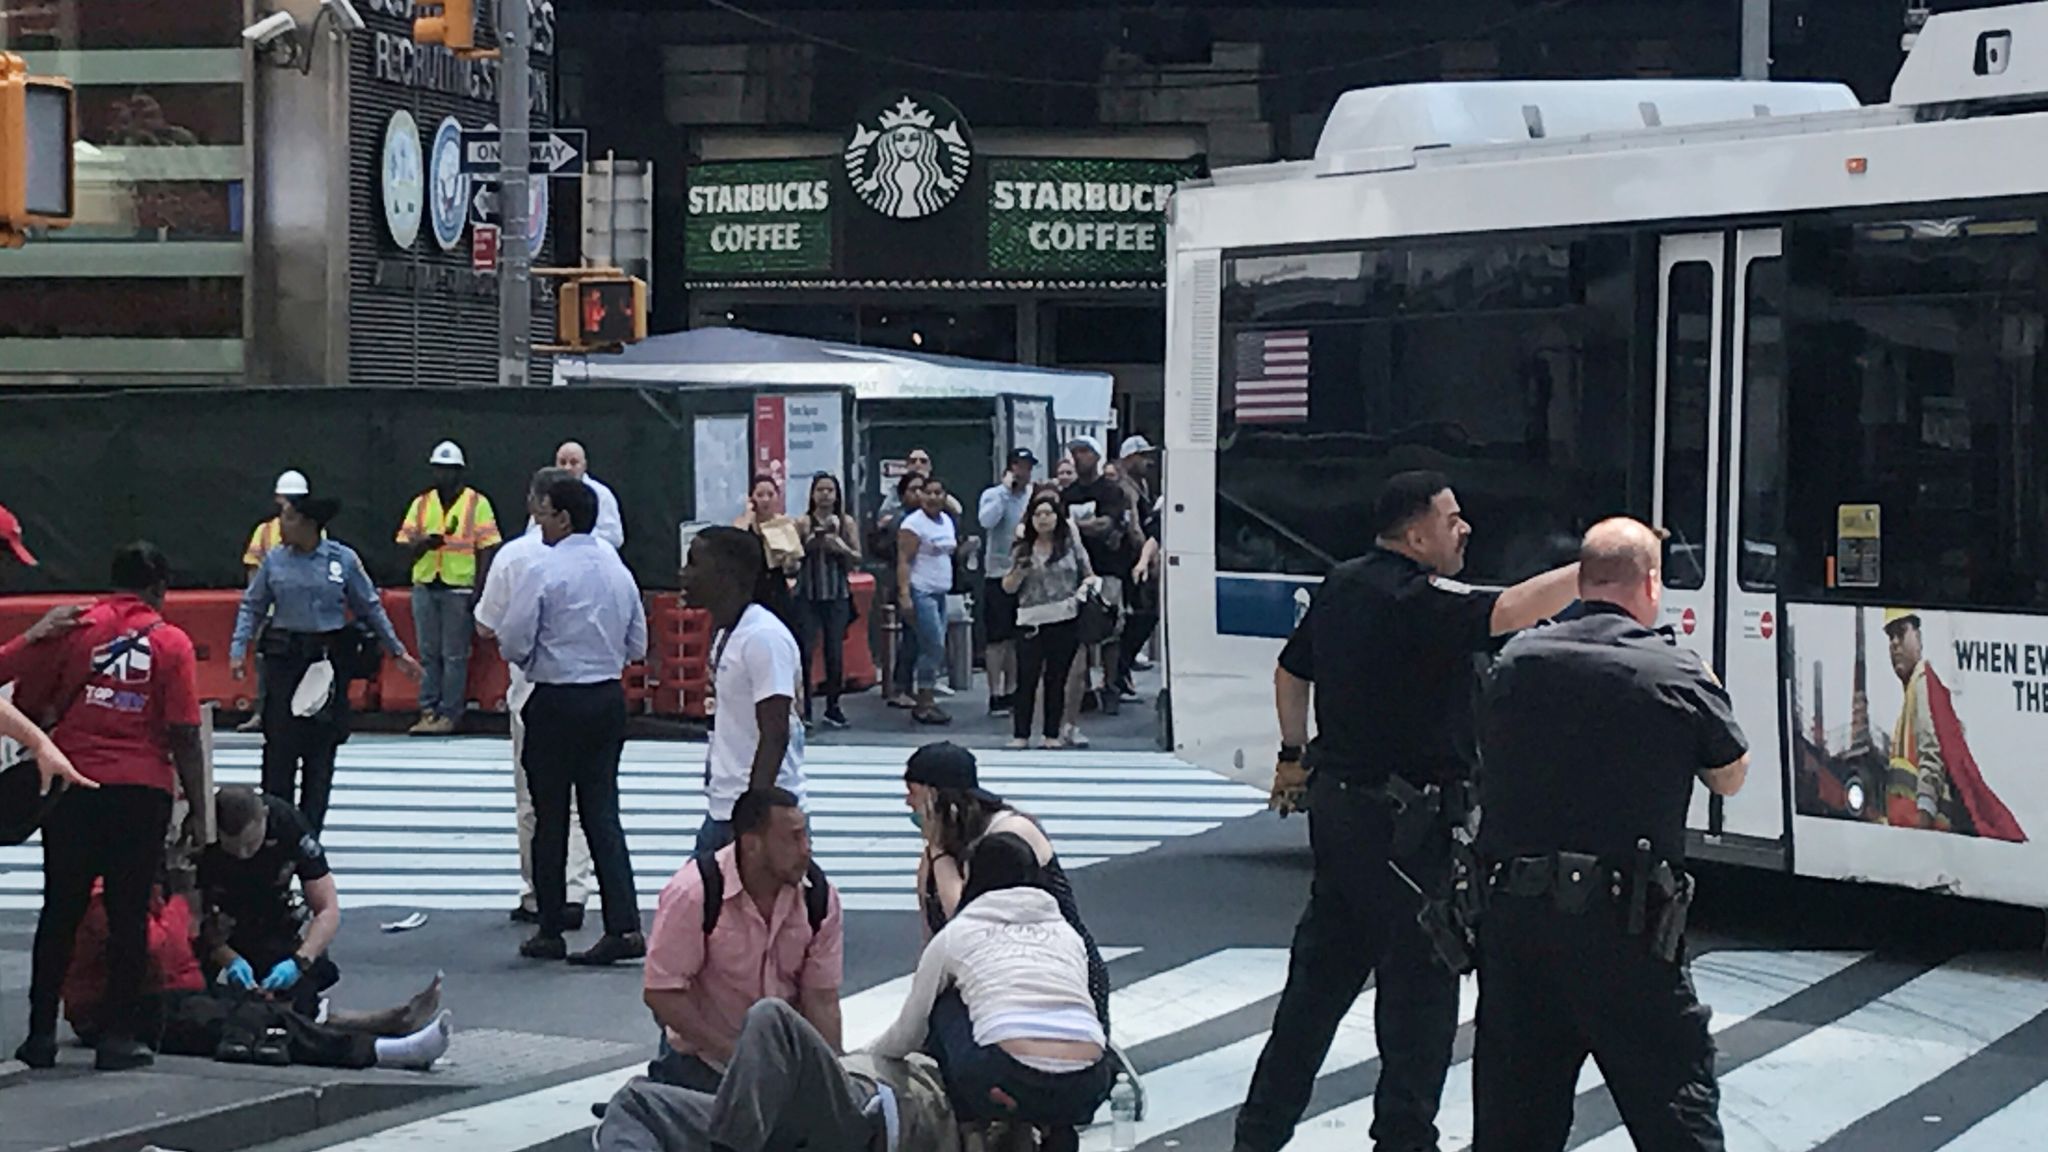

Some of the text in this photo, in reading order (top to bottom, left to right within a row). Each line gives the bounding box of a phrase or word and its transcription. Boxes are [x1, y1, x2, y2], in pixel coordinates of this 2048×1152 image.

[477, 144, 565, 161] ON WAY
[688, 180, 829, 214] STARBUCKS
[994, 181, 1173, 212] STARBUCK
[710, 222, 801, 252] COFFEE
[1029, 221, 1156, 250] COFFEE
[1955, 640, 2017, 674] WHEN
[2012, 680, 2048, 713] THE
